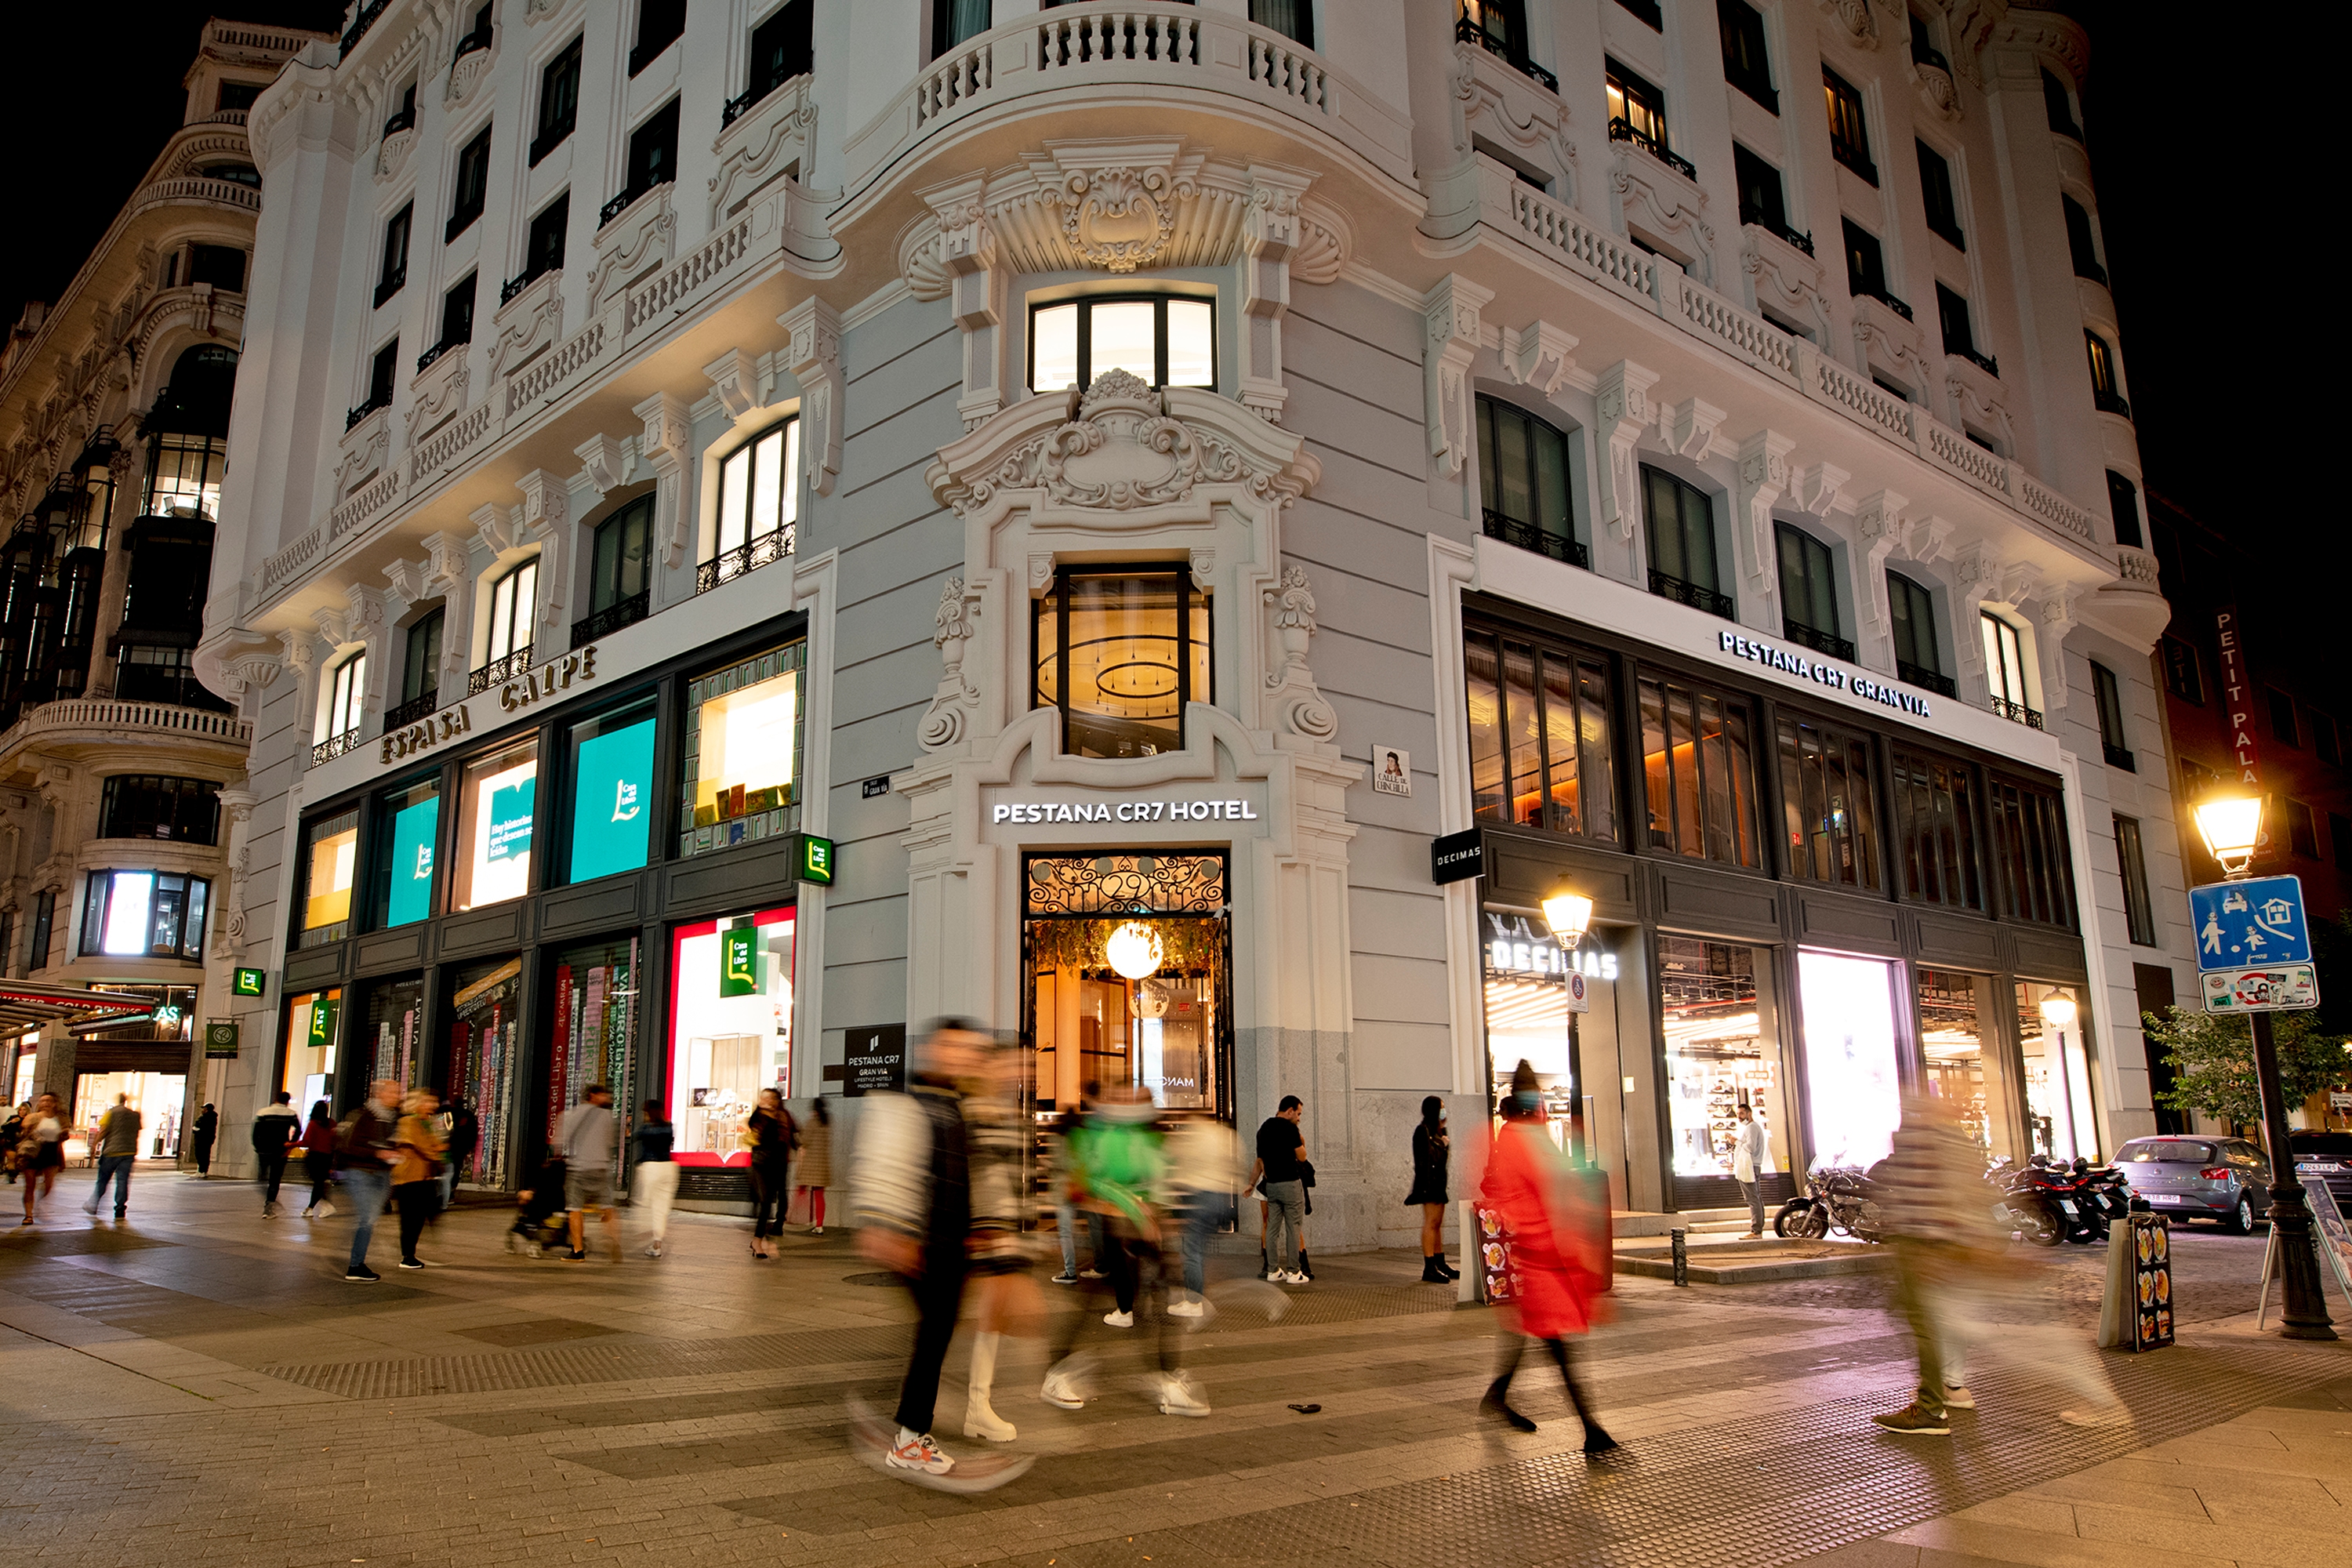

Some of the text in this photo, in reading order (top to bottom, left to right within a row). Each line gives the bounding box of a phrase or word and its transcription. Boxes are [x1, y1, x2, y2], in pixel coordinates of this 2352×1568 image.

[1719, 630, 1931, 717] PESTANA CR7 GRAN VIA
[379, 645, 597, 764] ESPASA CALPE
[2217, 613, 2258, 786] PETIT PALA
[622, 784, 637, 793] Casa
[1377, 781, 1410, 795] CHINCHILLA
[1378, 773, 1399, 784] CALLE
[622, 797, 636, 805] Libro
[993, 800, 1258, 823] PESTANA CR7 HOTEL
[492, 815, 532, 836] Hay historias
[490, 826, 533, 848] que desean se
[1437, 847, 1481, 866] DECIMAS
[1109, 874, 1141, 898] 29
[848, 1054, 899, 1065] PESTANA CR7
[547, 1045, 564, 1139] Casa del Libro
[477, 1078, 489, 1135] FASHION
